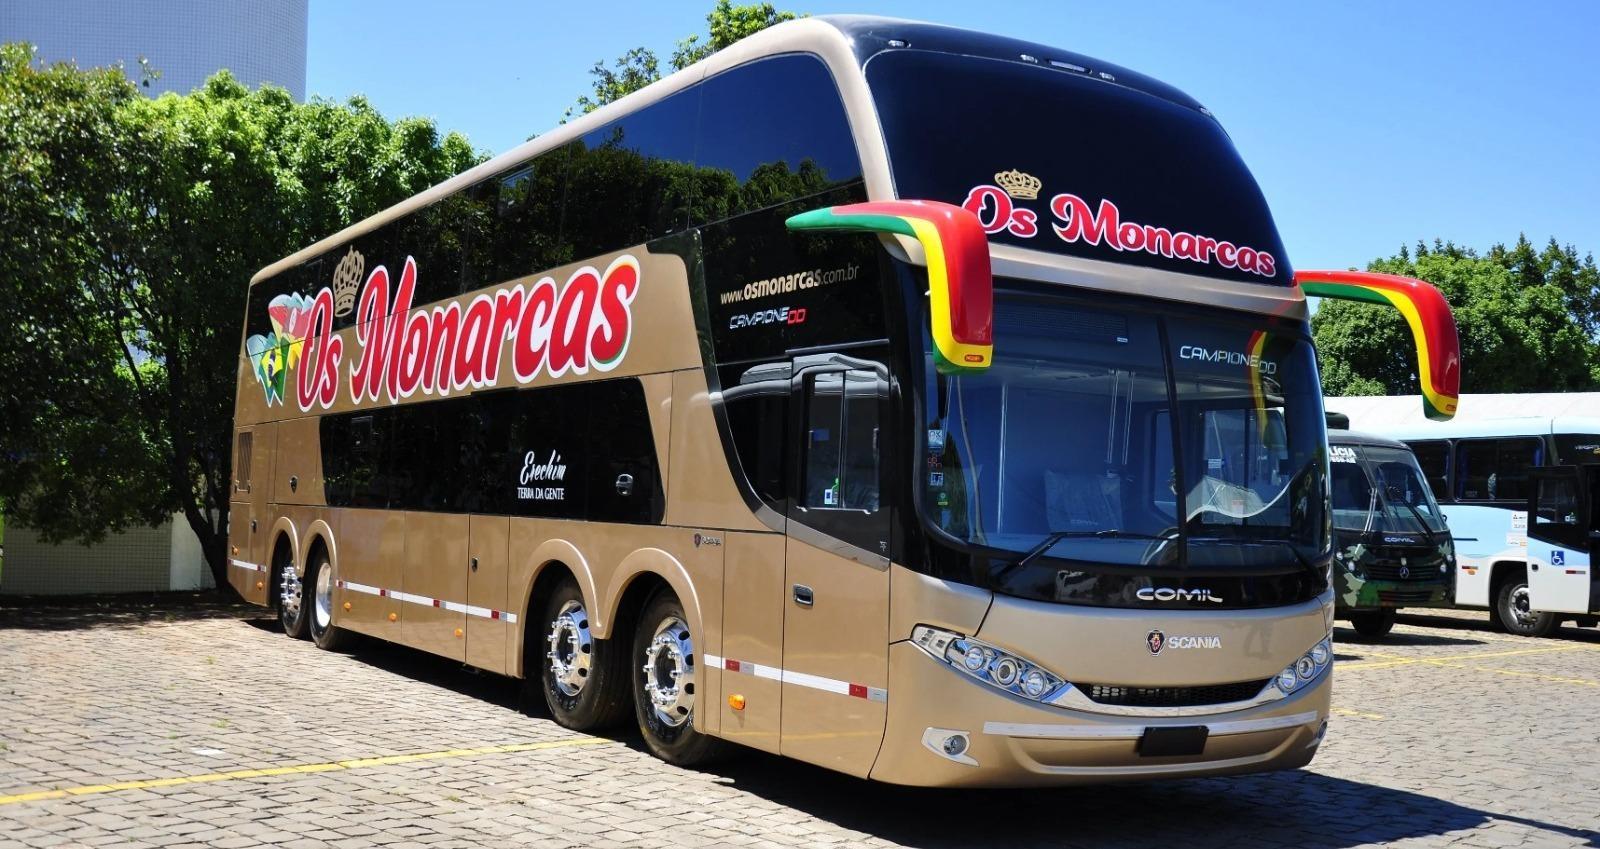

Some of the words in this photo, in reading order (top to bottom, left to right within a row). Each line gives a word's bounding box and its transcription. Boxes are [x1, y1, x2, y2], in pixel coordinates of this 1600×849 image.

[961, 185, 1037, 238] Os
[1050, 194, 1276, 277] Monarcas
[720, 262, 860, 304] www.osmonarcas.com.br
[297, 287, 343, 412] Os
[350, 254, 640, 405] Monarcas
[520, 449, 566, 485] Erechim
[517, 487, 534, 499] TERRA
[535, 488, 544, 499] DA
[544, 488, 565, 500] GENTE
[1136, 587, 1224, 603] COMIL
[1168, 636, 1222, 649] SCANIA
